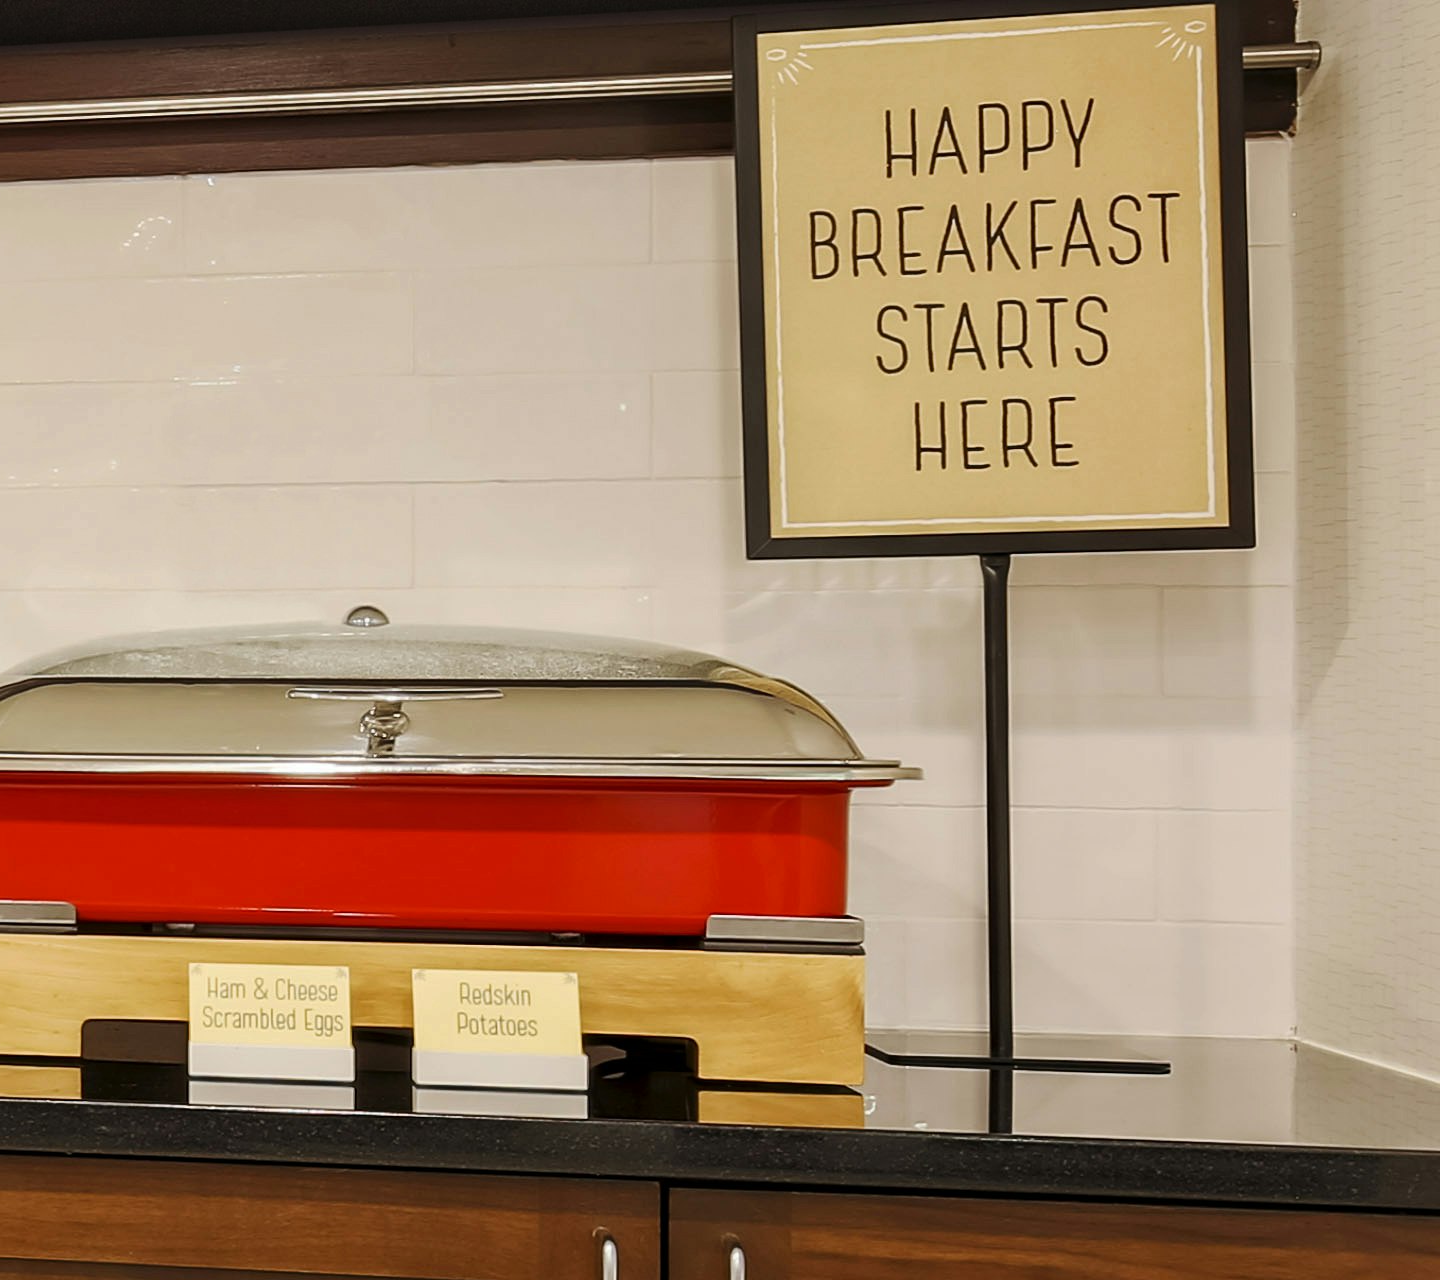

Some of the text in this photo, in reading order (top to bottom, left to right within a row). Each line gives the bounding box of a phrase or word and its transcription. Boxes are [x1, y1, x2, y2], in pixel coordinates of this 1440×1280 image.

[884, 97, 1095, 179] HAPPY
[809, 192, 1180, 280] BREAKFAST
[875, 295, 1110, 375] STARTS
[914, 396, 1080, 472] HERE
[206, 977, 338, 1002] Ham & Cheese
[459, 981, 531, 1006] Redskin
[202, 1006, 344, 1037] Scrambled Eggs
[457, 1011, 538, 1036] Potatoes
